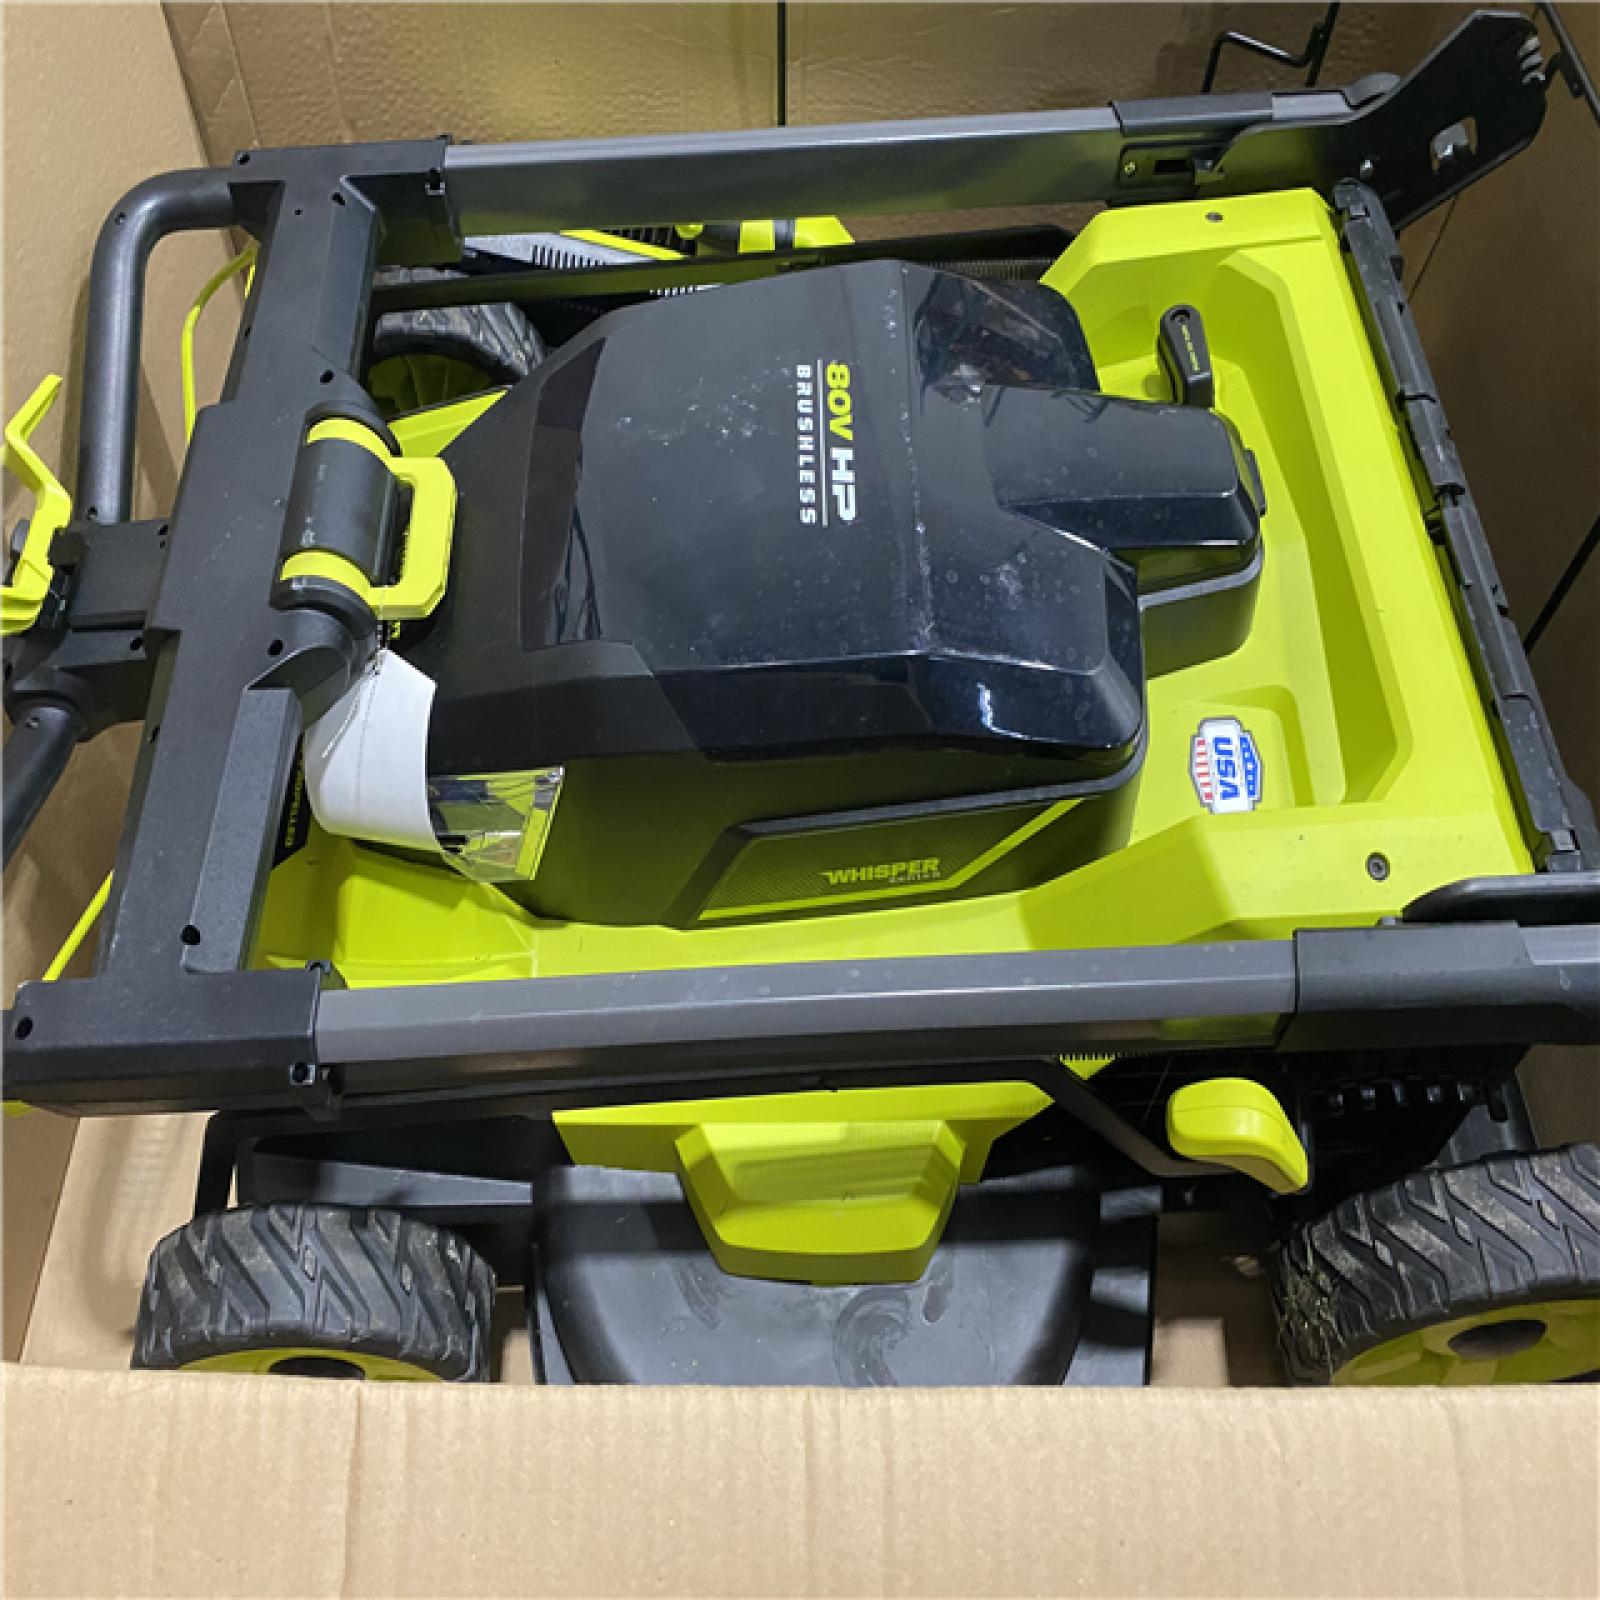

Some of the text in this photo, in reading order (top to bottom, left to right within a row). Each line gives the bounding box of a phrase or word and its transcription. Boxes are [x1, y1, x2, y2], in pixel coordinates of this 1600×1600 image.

[797, 364, 817, 525] BRUSHLESS
[826, 362, 856, 521] 80V HP
[1213, 736, 1240, 800] USA
[819, 858, 940, 885] WHISPER
